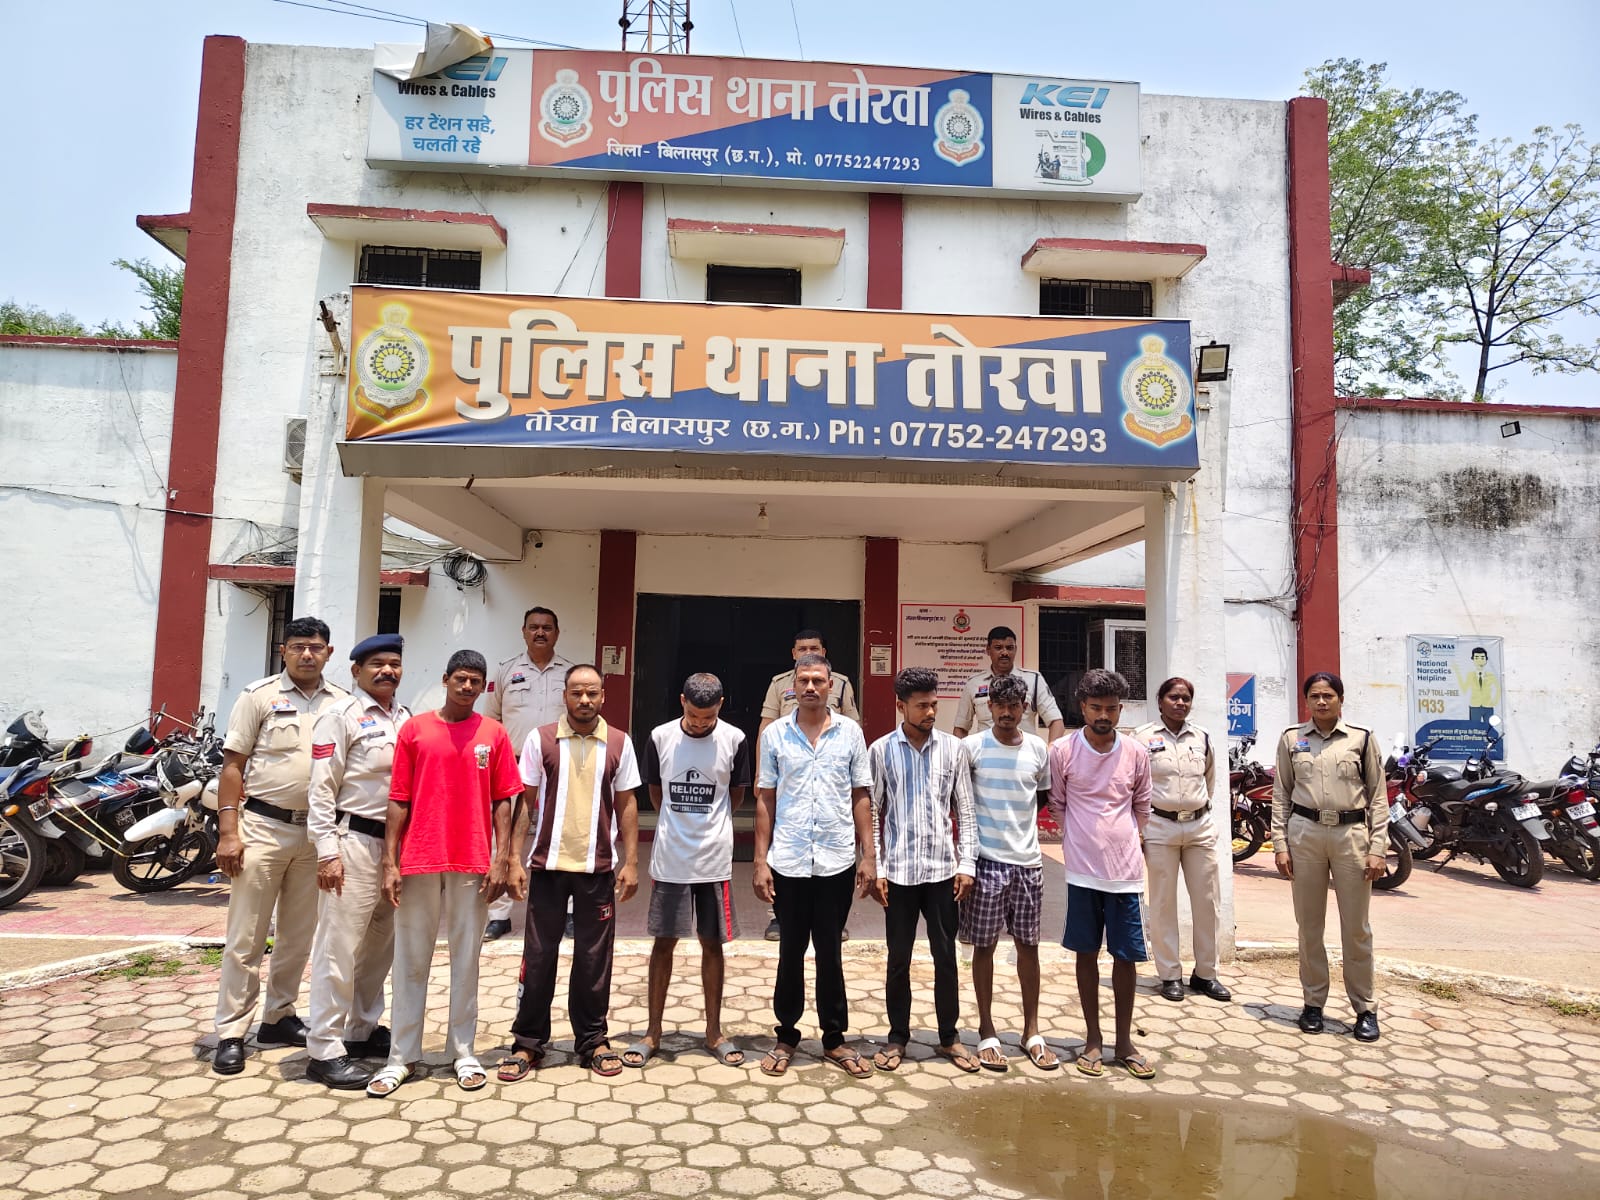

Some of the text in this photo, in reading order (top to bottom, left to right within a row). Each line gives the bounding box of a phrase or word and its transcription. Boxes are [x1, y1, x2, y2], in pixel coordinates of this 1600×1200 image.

[424, 56, 509, 81] EI
[397, 82, 496, 98] Wires & Cables
[597, 57, 931, 128] पुलिस थाना तोरवा
[1019, 82, 1110, 110] KEI
[404, 112, 496, 135] हर टेंशन सहे,
[1019, 108, 1102, 124] Wires & Cables
[412, 135, 483, 154] चलती रहे
[657, 140, 719, 166] बिलासपुर
[786, 147, 807, 166] मो.
[814, 152, 921, 172] 07752247293
[447, 308, 1107, 422] पुलिस थाना तोरवा
[525, 407, 598, 434] तोरवा
[611, 408, 730, 444] बिलासपुर
[741, 417, 820, 441] (छ.ग.)
[829, 418, 865, 446] Ph
[889, 420, 1107, 453] 07752-247293
[1417, 675, 1447, 683] Helpline
[1418, 698, 1445, 713] 1933
[671, 785, 713, 795] RELICON
[681, 795, 703, 803] TURBO
